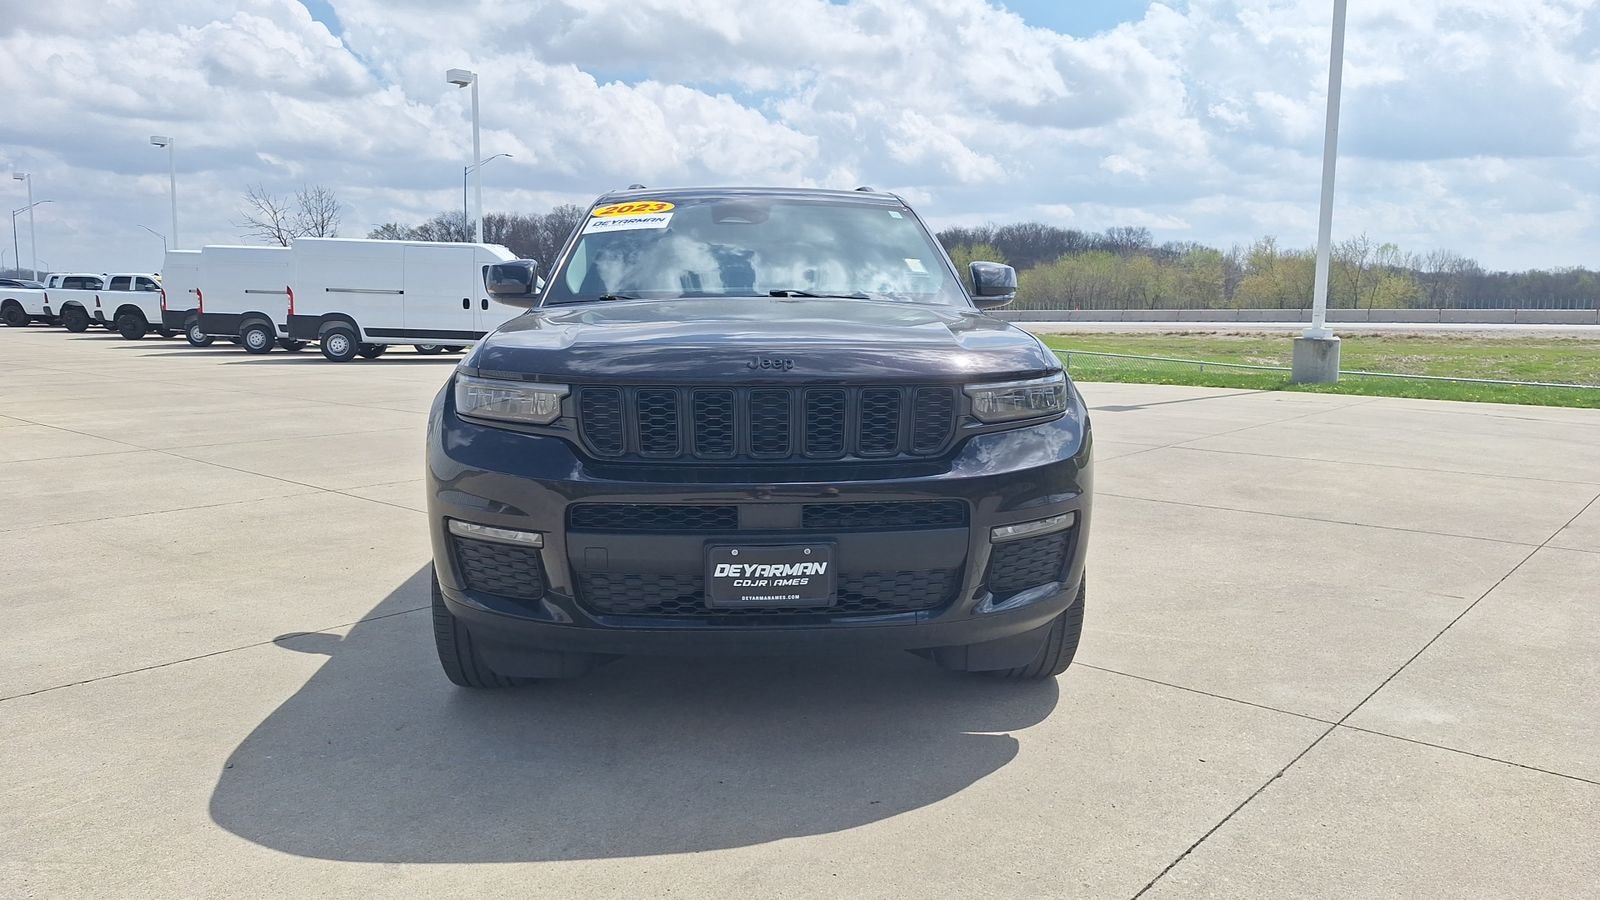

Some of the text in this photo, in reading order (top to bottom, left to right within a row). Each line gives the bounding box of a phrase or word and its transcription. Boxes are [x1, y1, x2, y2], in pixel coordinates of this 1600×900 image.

[599, 203, 667, 214] 2023
[746, 354, 795, 372] Jeep
[713, 562, 827, 577] DEYARMAN
[733, 578, 809, 587] CDJR AMES
